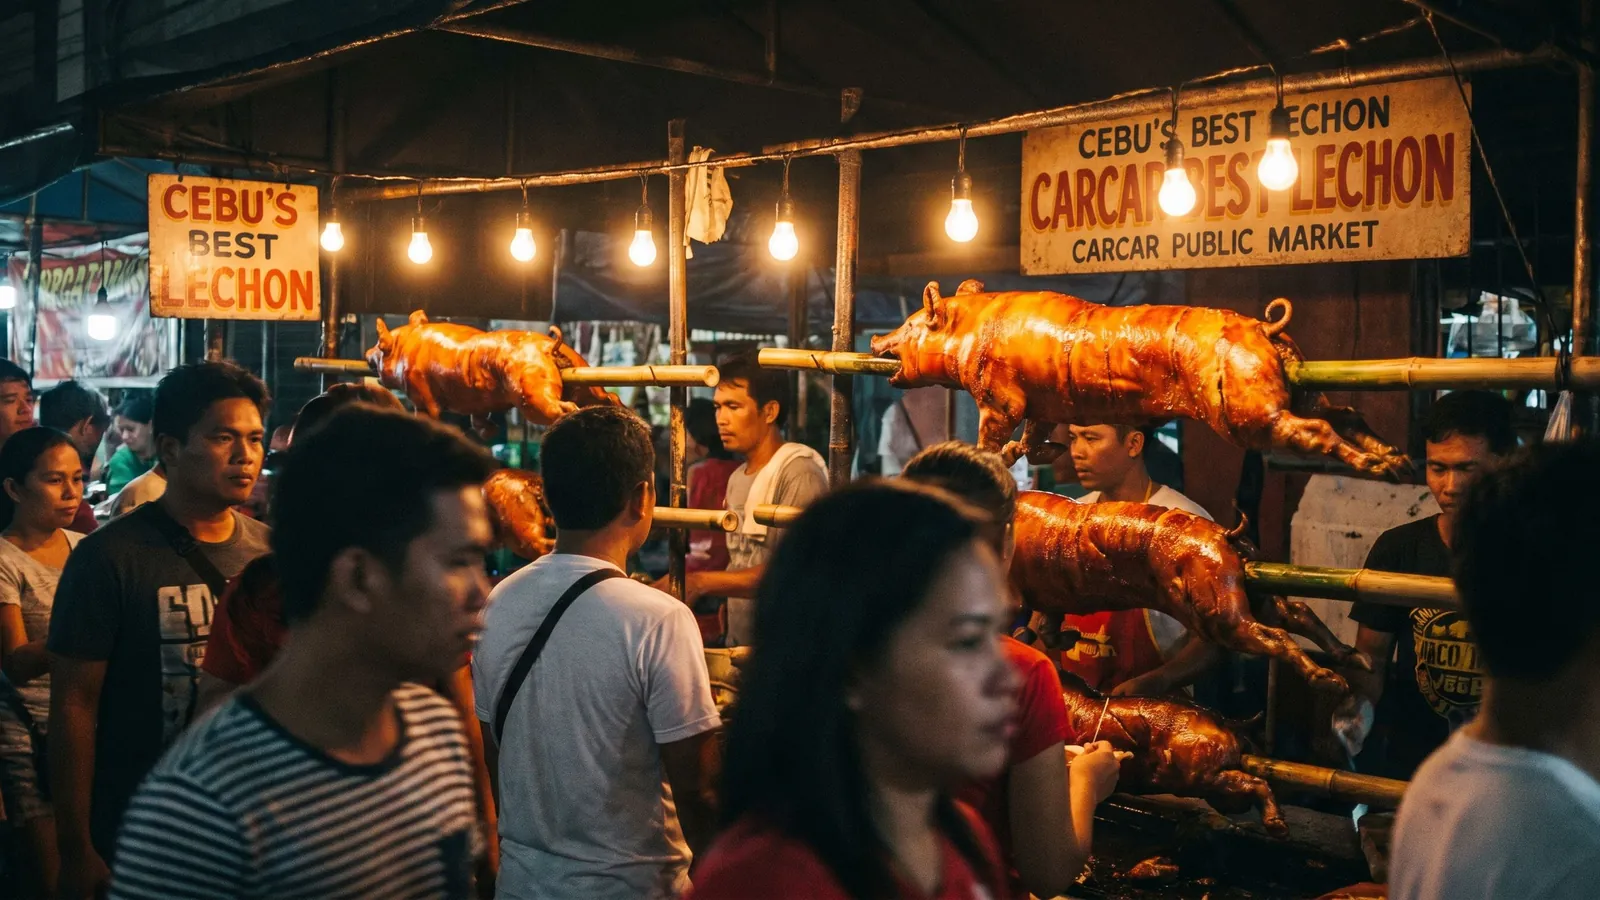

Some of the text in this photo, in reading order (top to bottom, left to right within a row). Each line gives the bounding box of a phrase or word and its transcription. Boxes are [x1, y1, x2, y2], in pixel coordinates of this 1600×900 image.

[1191, 110, 1256, 147] BEST
[1286, 95, 1390, 138] ECHON
[1290, 133, 1455, 215] LECHON
[162, 184, 298, 228] CEBU'S
[188, 229, 278, 260] BEST
[1072, 220, 1379, 264] CARCAR PUBLIC MARKET
[161, 265, 314, 311] LECHON
